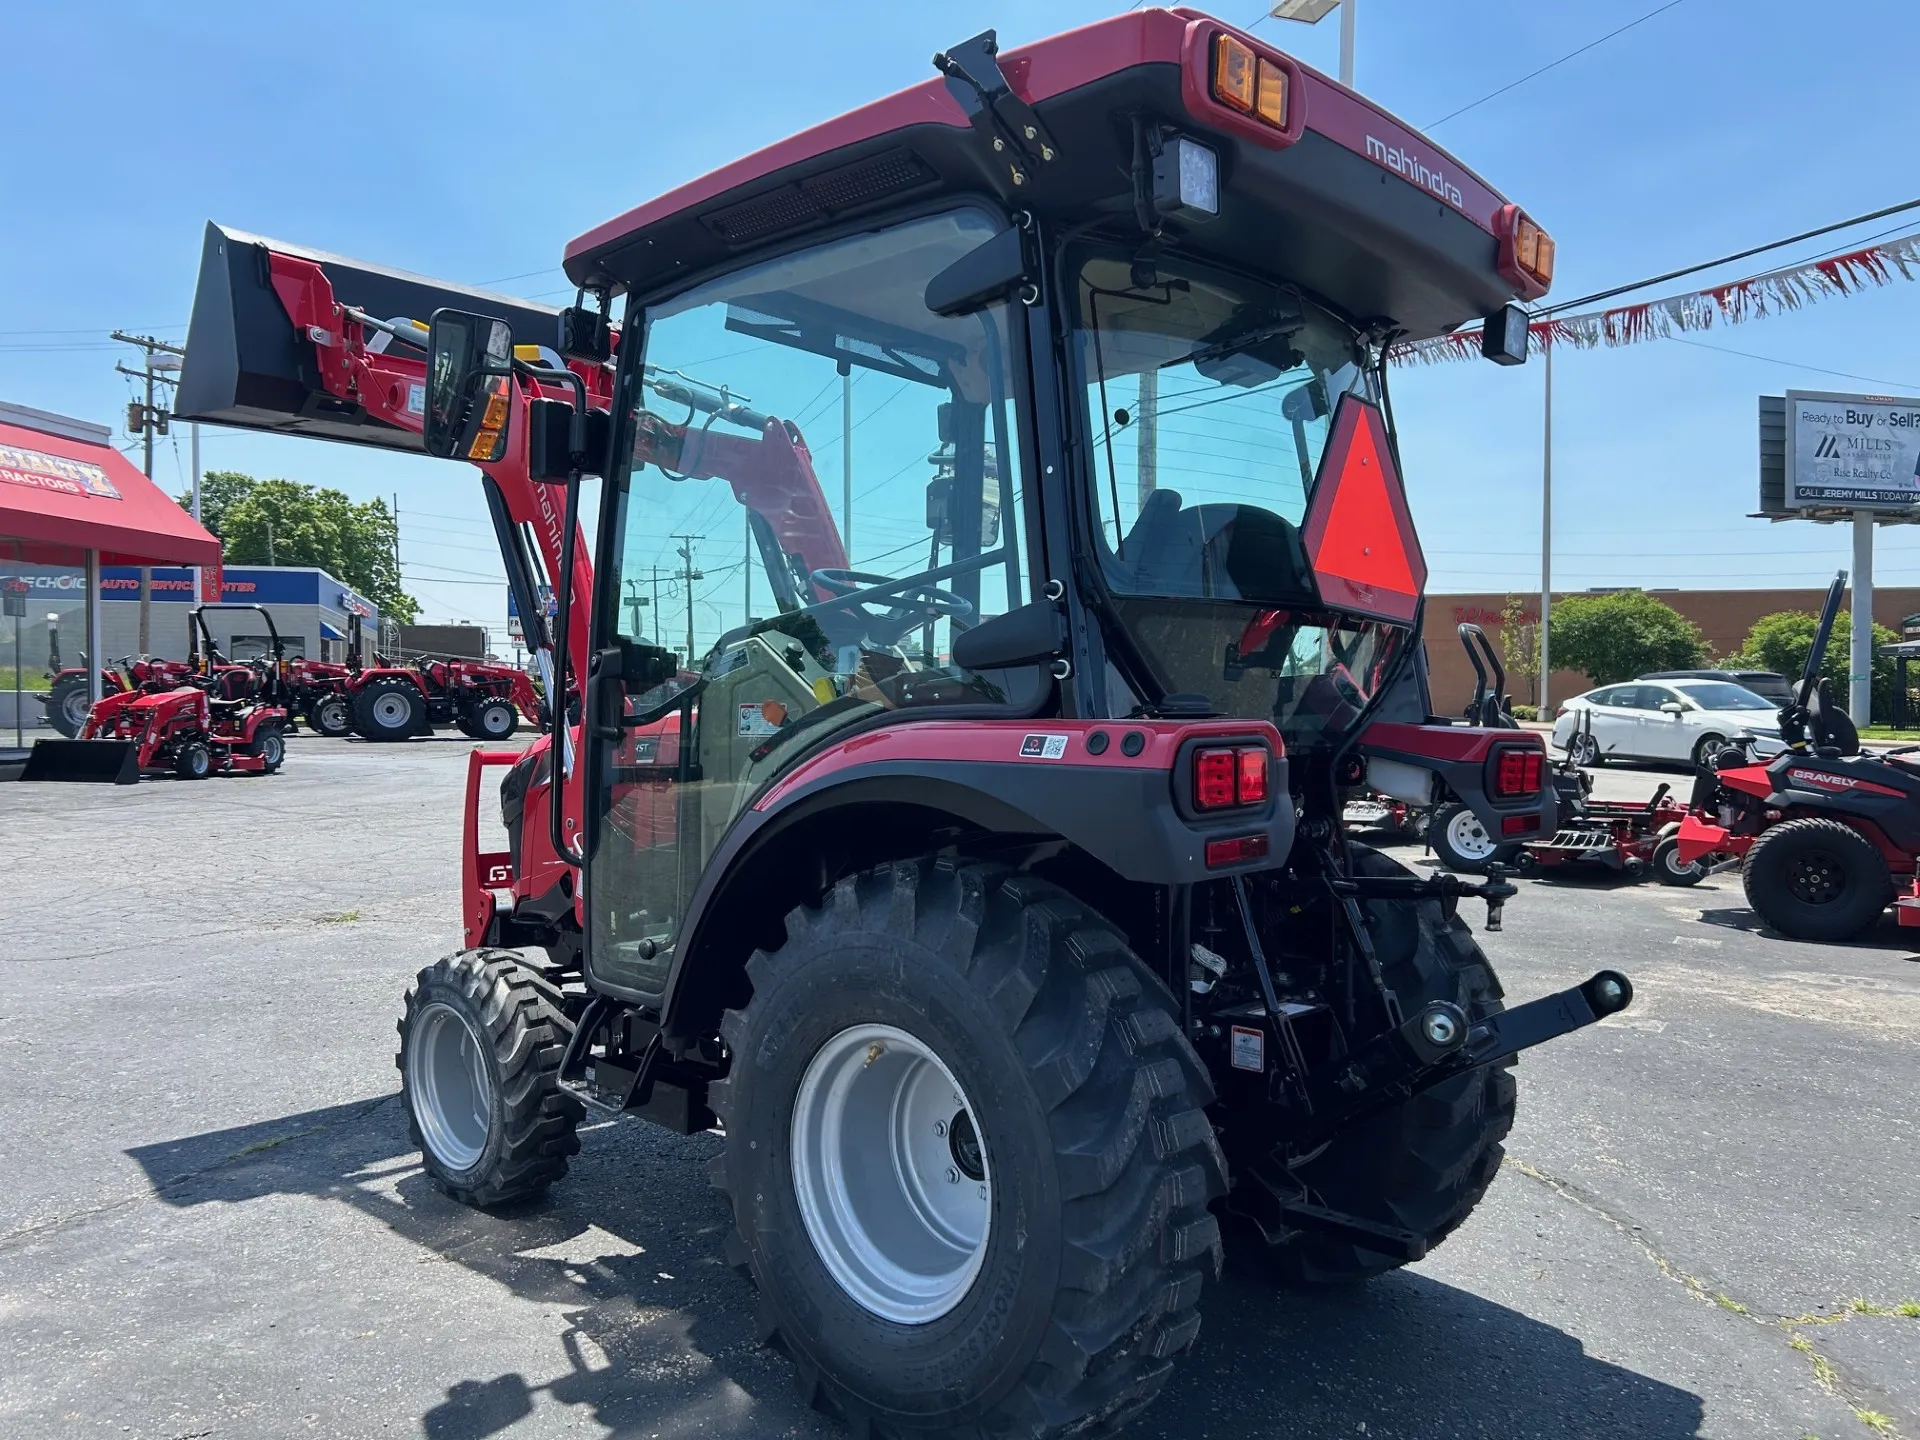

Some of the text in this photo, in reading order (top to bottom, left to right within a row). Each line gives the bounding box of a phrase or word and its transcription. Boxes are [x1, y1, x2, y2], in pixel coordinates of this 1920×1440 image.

[1366, 134, 1462, 208] mahindra
[1802, 410, 1920, 428] Ready to Buy or Sell?
[1847, 437, 1892, 451] MILLS
[1834, 467, 1851, 478] Rise
[1853, 467, 1879, 481] Realty
[1800, 488, 1822, 497] CALL
[1822, 489, 1854, 499] JEREMY
[1855, 490, 1878, 500] MILLS
[1879, 492, 1909, 502] TODAY!
[100, 579, 140, 590] AUTO
[150, 579, 195, 591] ERVIC
[220, 582, 256, 593] NTER
[1793, 770, 1858, 787] GRAVELY
